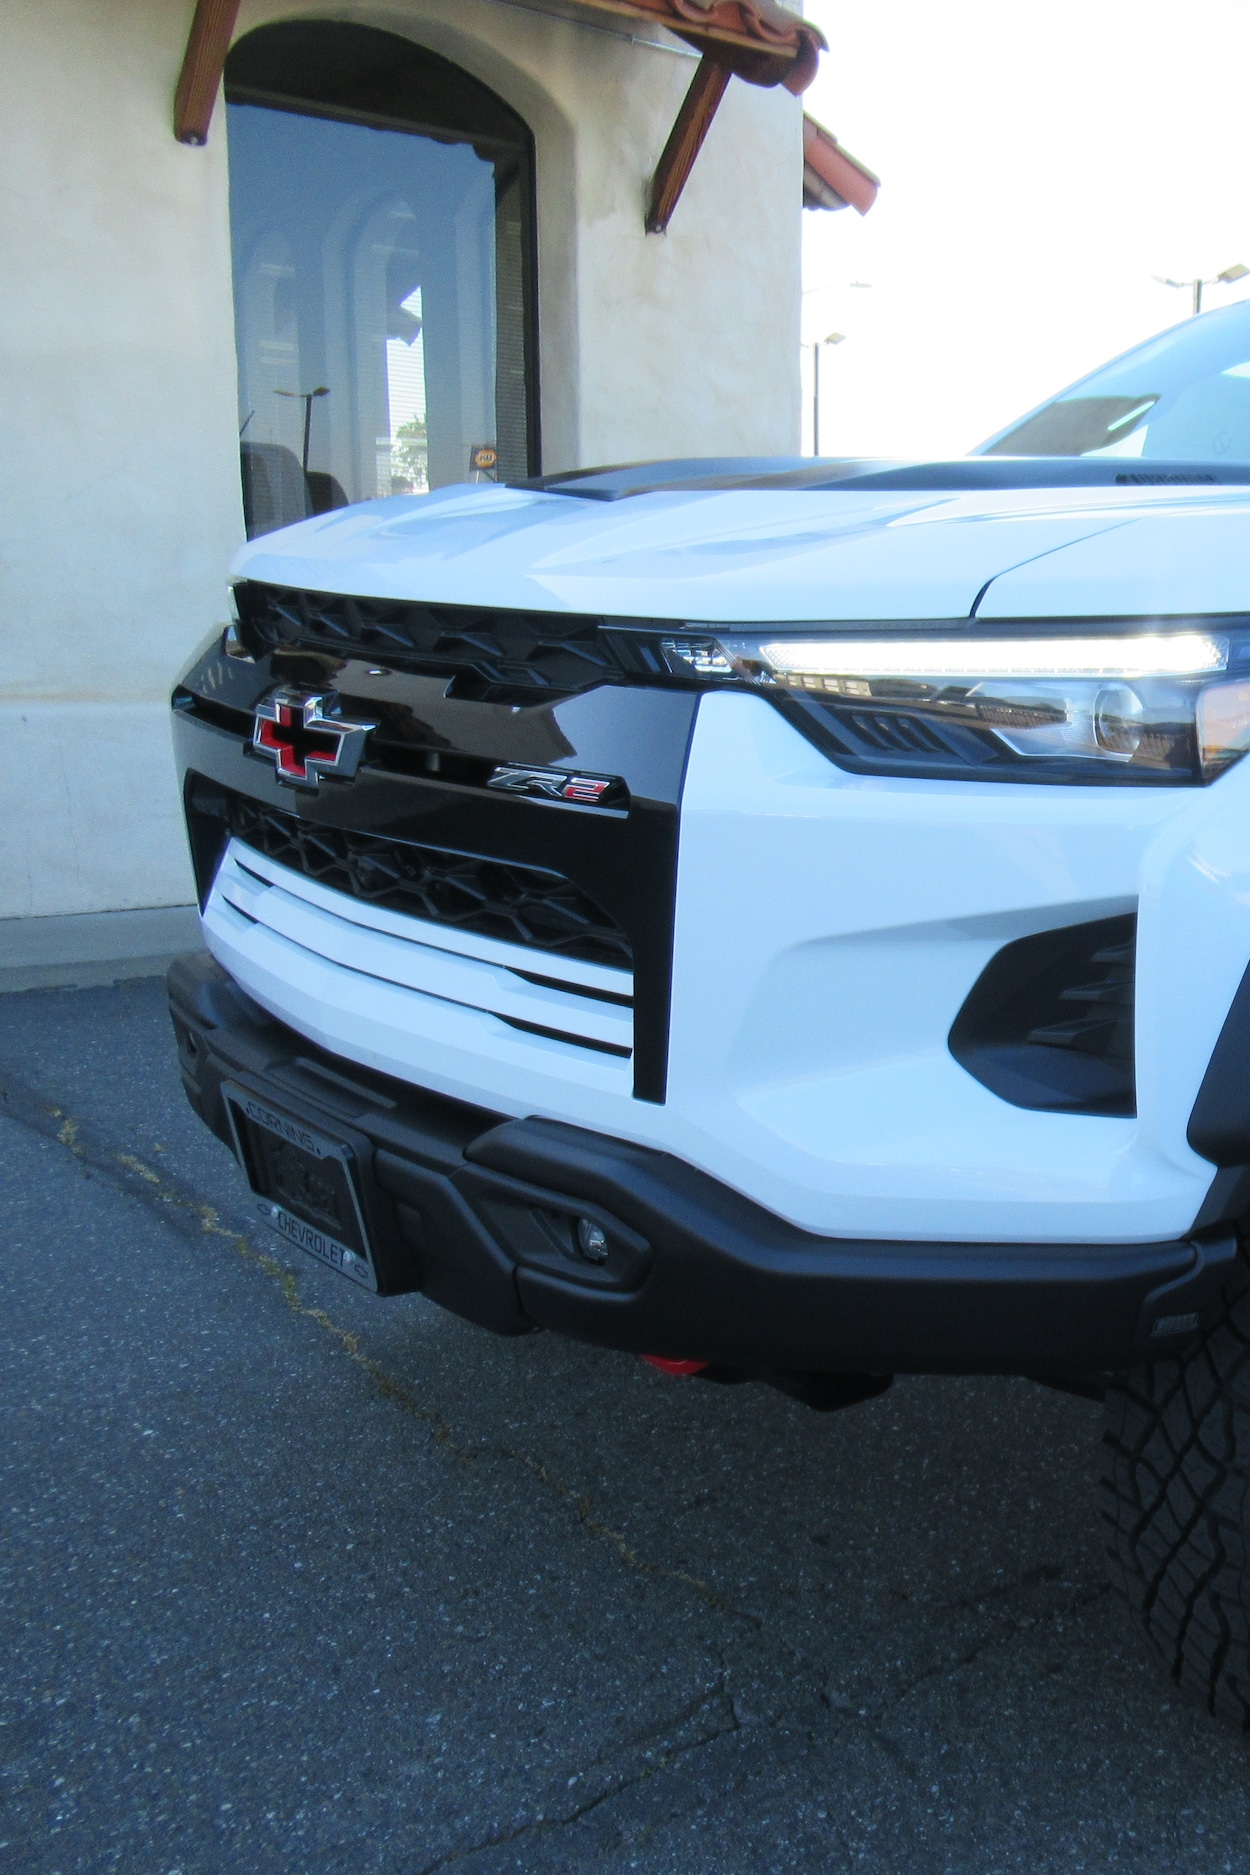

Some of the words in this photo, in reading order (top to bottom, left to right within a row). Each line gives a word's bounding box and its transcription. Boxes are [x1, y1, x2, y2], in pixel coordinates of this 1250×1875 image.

[487, 765, 611, 803] ZR2
[248, 1101, 316, 1154] CORNING
[277, 1210, 345, 1267] CHEVROLET
